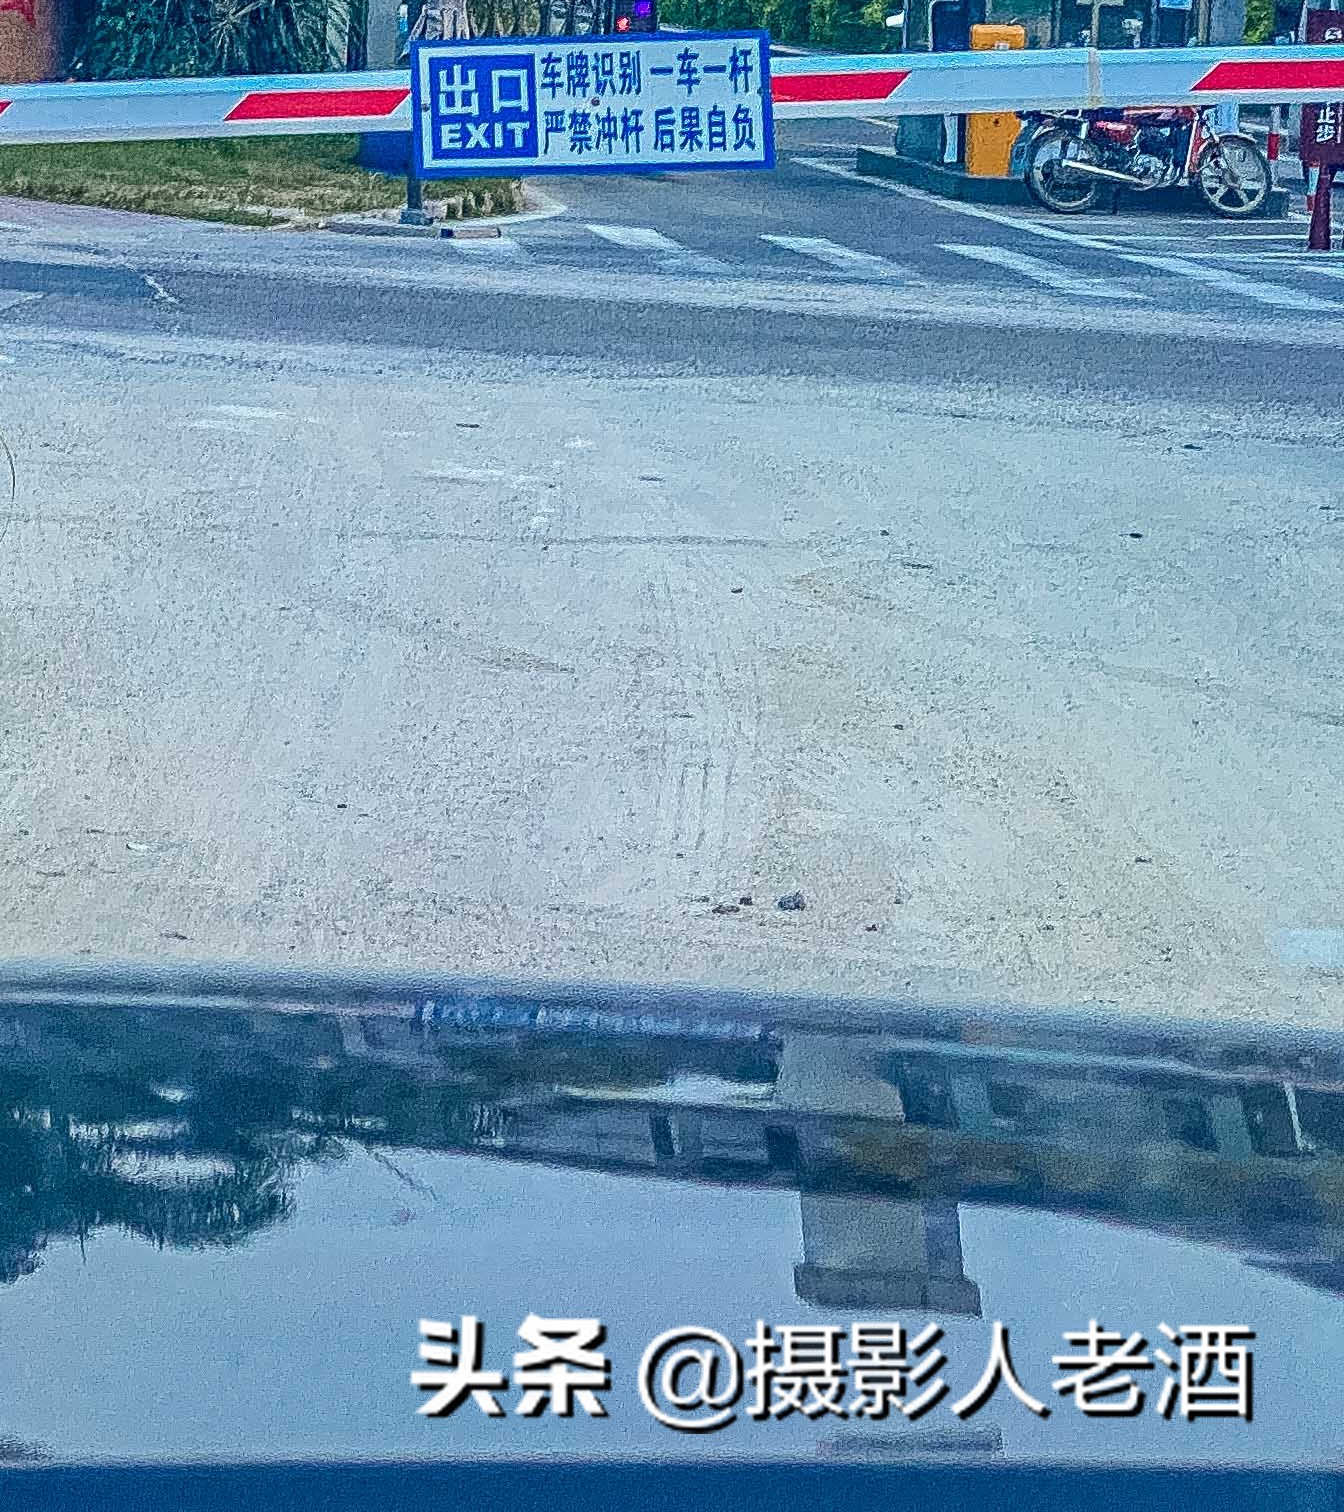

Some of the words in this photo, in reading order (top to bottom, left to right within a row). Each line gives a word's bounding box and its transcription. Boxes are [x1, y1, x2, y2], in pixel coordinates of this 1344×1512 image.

[438, 64, 530, 117] 出口
[540, 49, 643, 100] 车牌识别
[648, 46, 755, 96] 一车一杆
[440, 120, 531, 150] EXIT
[543, 106, 645, 155] 严禁冲杆
[653, 102, 757, 154] 后果自负
